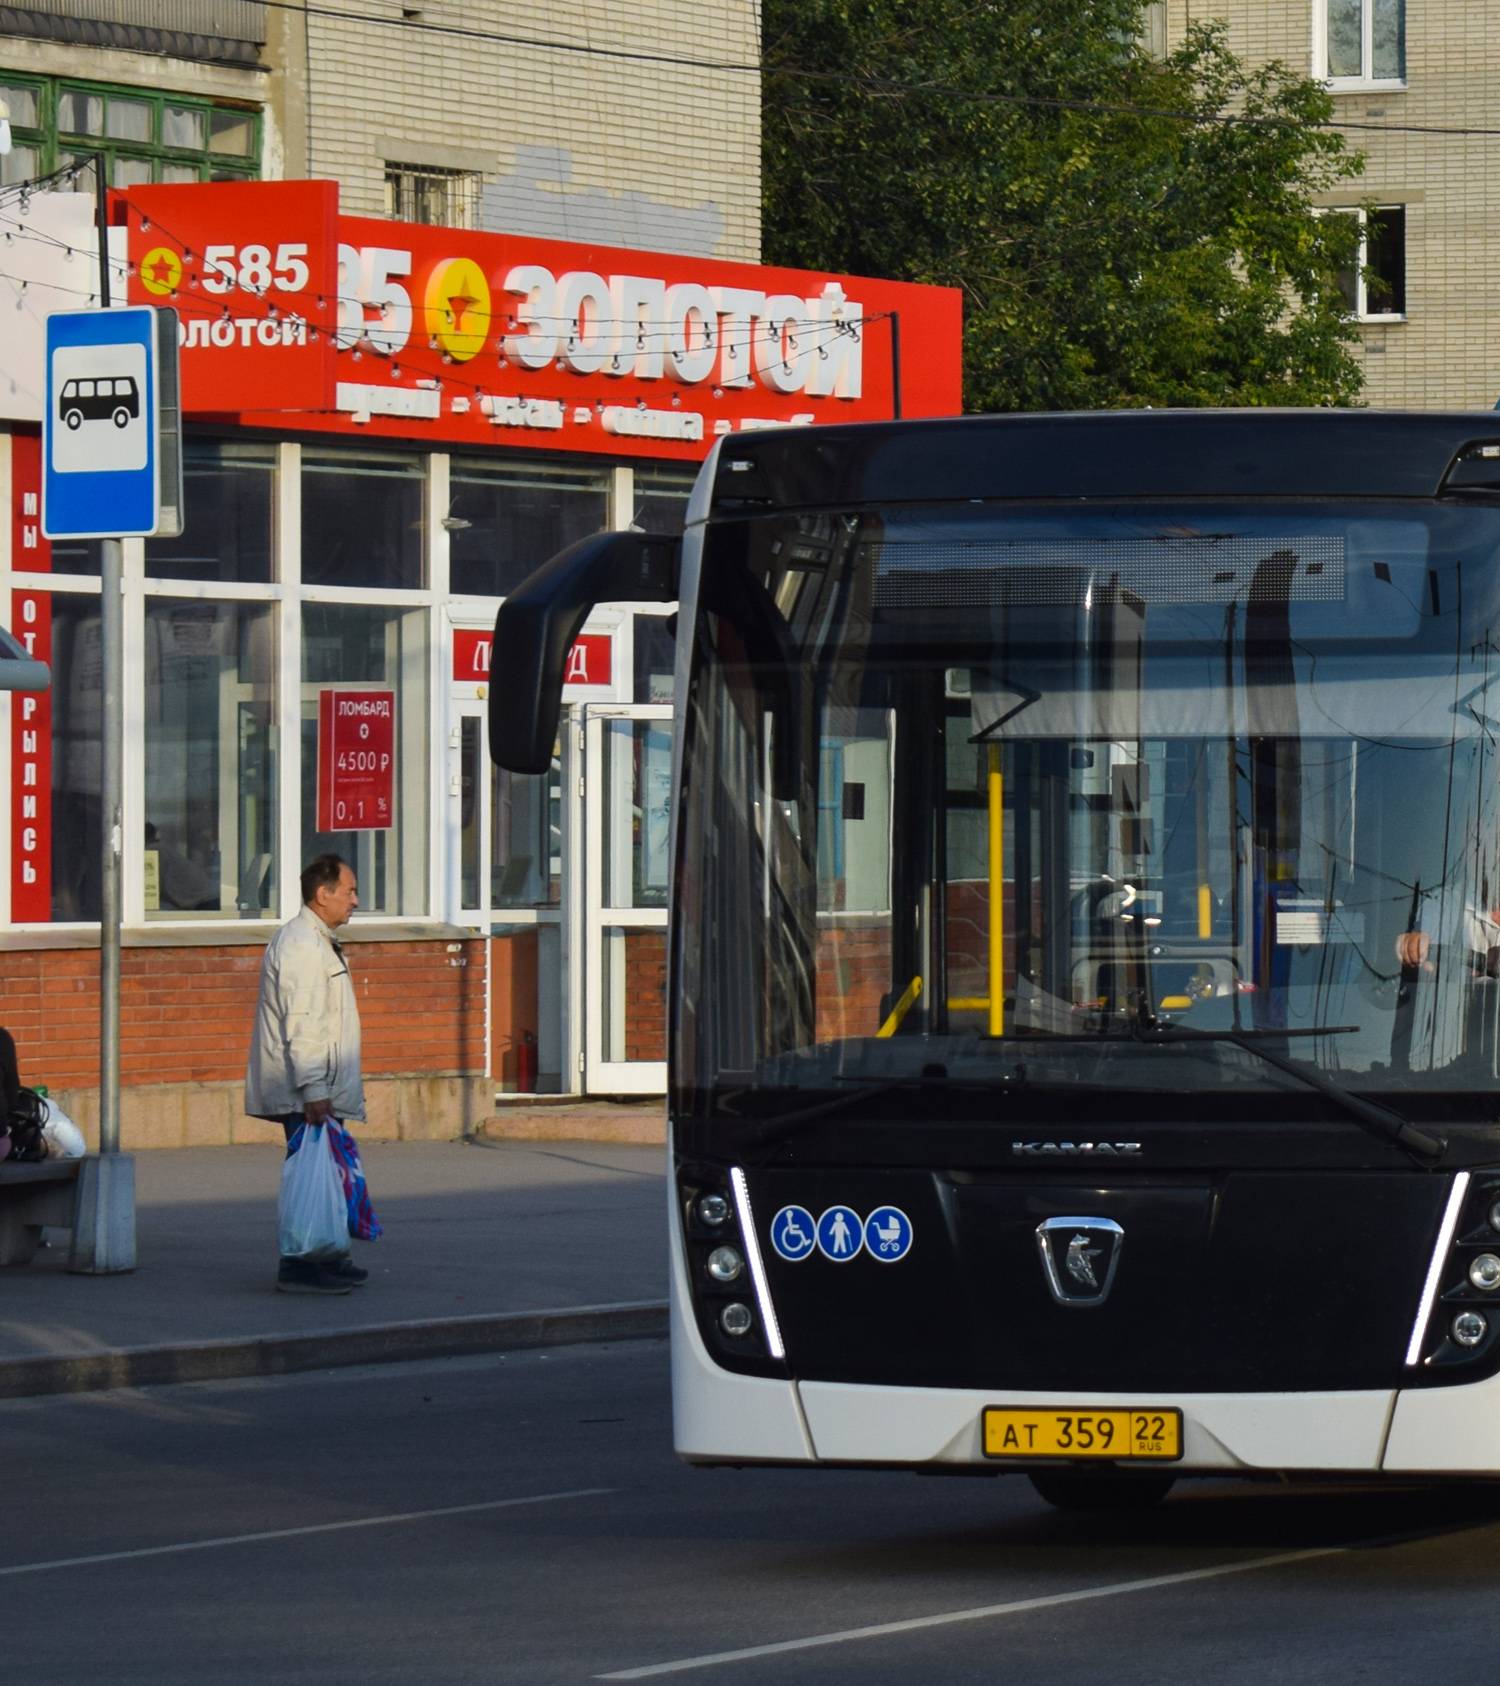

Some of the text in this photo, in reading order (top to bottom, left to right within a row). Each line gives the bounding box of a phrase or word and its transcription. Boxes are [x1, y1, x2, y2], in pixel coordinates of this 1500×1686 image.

[202, 244, 309, 295] 585
[503, 265, 863, 399] ЗОЛОТОЙ
[23, 492, 37, 548] МЫ
[339, 701, 390, 718] ЛОМБАРД
[23, 599, 37, 883] ОТРЫЛИСЬ
[338, 752, 376, 771] 4500
[1056, 1416, 1115, 1449] 359
[1135, 1416, 1165, 1441] 22
[1139, 1442, 1162, 1451] RUS
